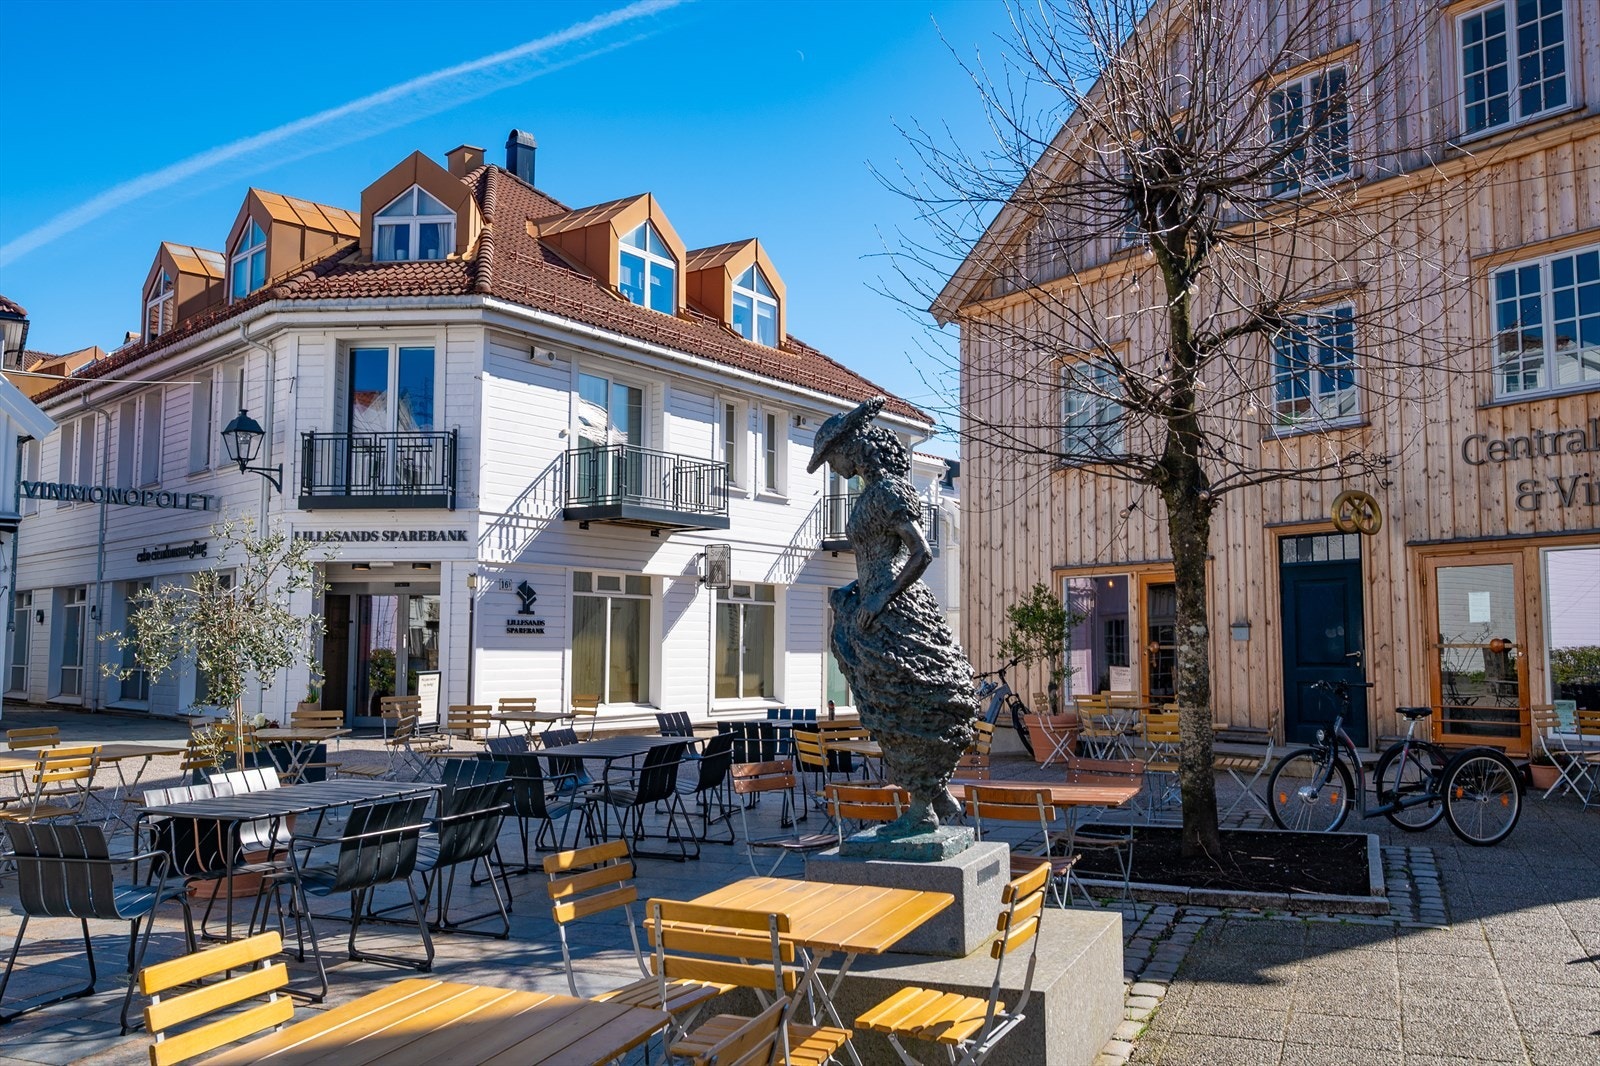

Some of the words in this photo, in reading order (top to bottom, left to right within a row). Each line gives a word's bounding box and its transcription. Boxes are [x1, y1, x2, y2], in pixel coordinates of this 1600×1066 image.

[22, 480, 215, 511] VINMONOPOLET
[1515, 479, 1546, 511] &
[293, 530, 379, 542] LILLESANDS
[381, 530, 468, 542] SPAREBANK
